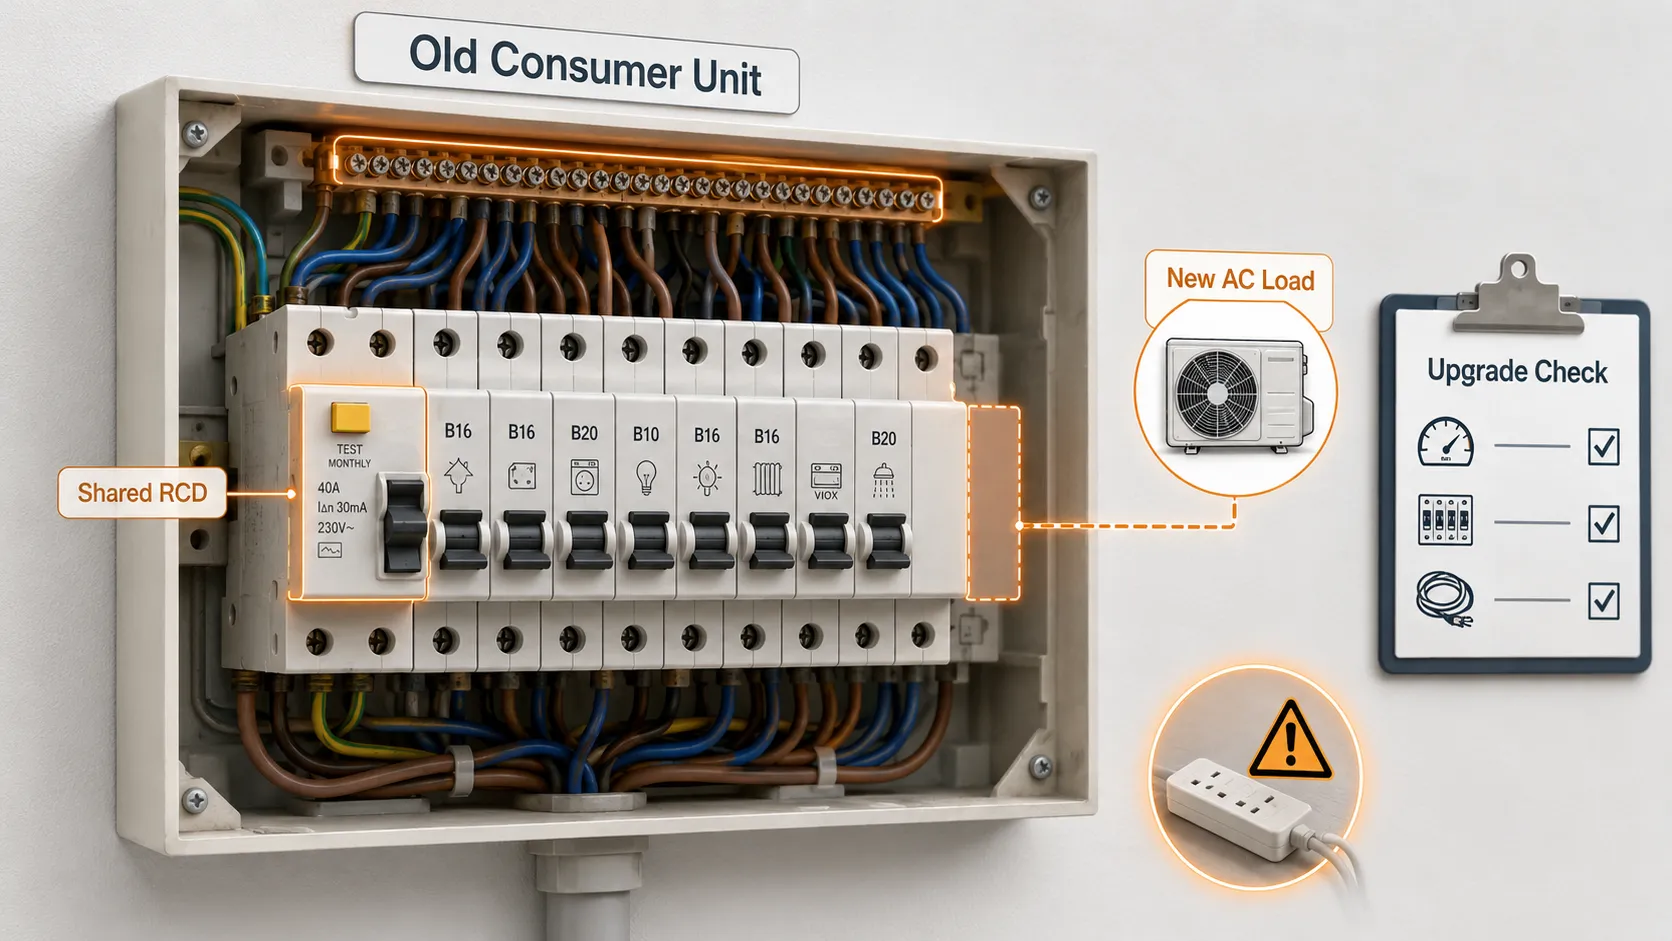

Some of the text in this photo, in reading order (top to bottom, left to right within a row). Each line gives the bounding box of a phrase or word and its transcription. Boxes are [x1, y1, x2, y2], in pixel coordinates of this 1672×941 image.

[409, 34, 762, 97] Old Consumer Unit
[1428, 357, 1608, 387] Upgrade Check
[445, 422, 472, 439] B16
[508, 423, 536, 440] B16
[571, 424, 598, 441] B20
[633, 426, 660, 442] B10
[694, 427, 721, 443] B16
[754, 428, 780, 444] B16
[871, 430, 897, 446] B20
[337, 443, 363, 455] TEST
[328, 459, 371, 468] MONTHLY
[317, 481, 341, 494] 40A
[814, 491, 838, 501] VIOX
[336, 501, 368, 513] 30mA
